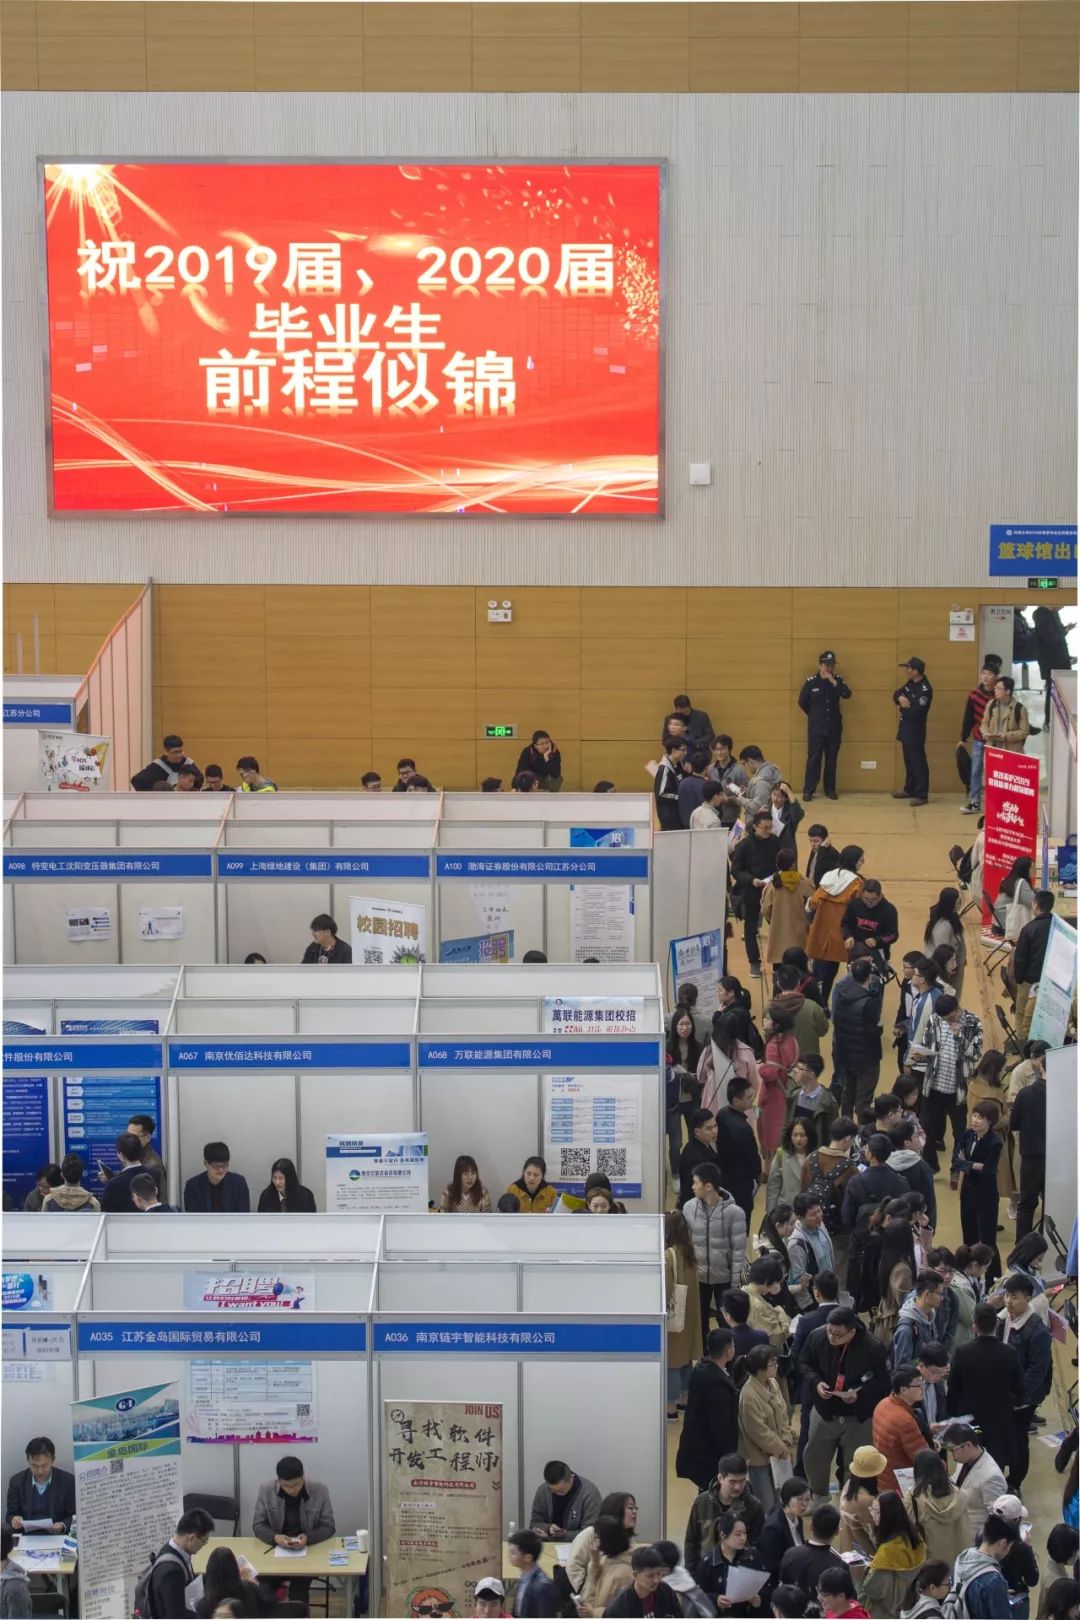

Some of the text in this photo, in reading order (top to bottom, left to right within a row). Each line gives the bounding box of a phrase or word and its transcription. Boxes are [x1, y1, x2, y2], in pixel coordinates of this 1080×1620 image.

[249, 303, 444, 352] 毕业生
[199, 350, 516, 409] 前程似锦
[998, 542, 1077, 560] 篮球馆出
[8, 861, 160, 871] A098 特变电工沈阳变压器集团有限公司
[444, 861, 596, 872] A100 渤海证券股份有限公司江苏分公司
[357, 914, 419, 941] 校园招聘
[552, 1009, 636, 1022] 萬联能源集团校招
[3, 1051, 73, 1062] 件股份有限公司
[178, 1050, 312, 1062] A067 南京优佰达科技有限公司
[428, 1049, 552, 1060] A068 万联能源集团有限公司
[90, 1331, 261, 1343] A035 江苏金岛国际贸易有限公司
[385, 1332, 555, 1344] A036 南京链宇智能科技有限公司
[464, 1404, 500, 1419] JOIN US
[397, 1418, 496, 1446] 寻找软件
[389, 1447, 500, 1472] 开发工程师
